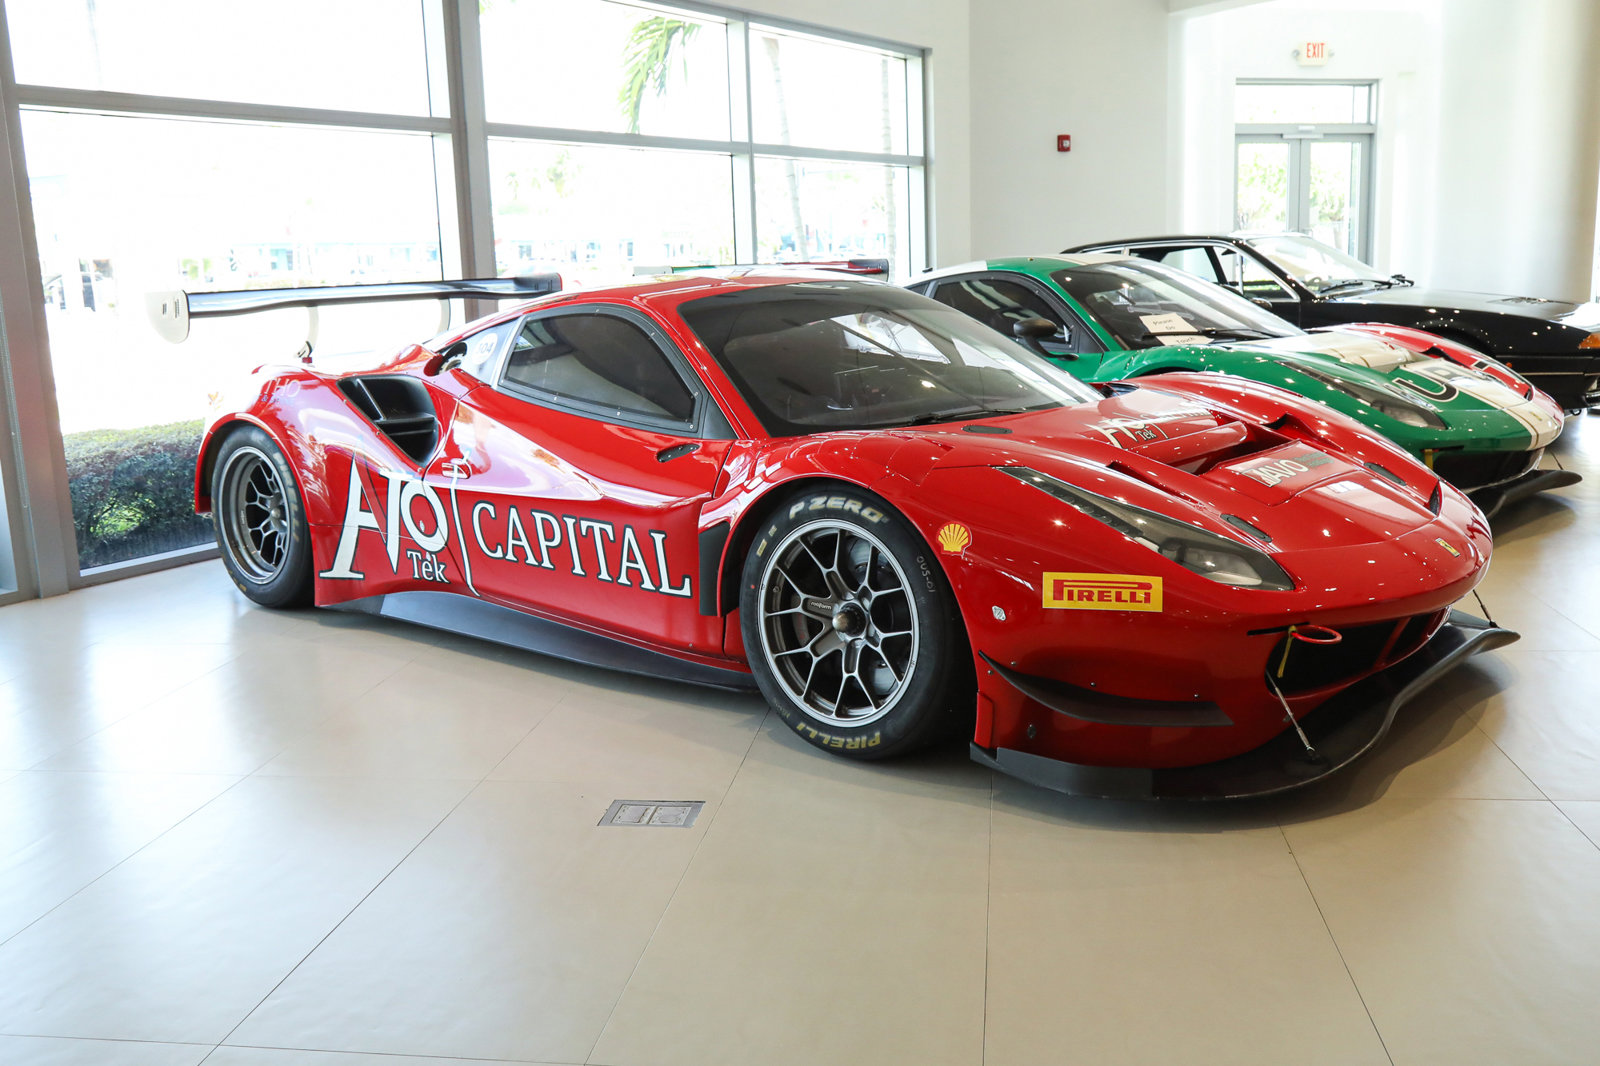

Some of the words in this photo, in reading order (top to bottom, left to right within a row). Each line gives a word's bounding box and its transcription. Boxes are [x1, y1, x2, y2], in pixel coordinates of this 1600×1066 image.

[1306, 42, 1326, 59] EXIT
[789, 500, 805, 520] P
[808, 495, 884, 524] ZERO
[472, 500, 693, 599] CAPITAL
[406, 549, 451, 584] Tek
[1052, 579, 1152, 604] PIRELLI
[796, 721, 881, 750] PIRELLI
